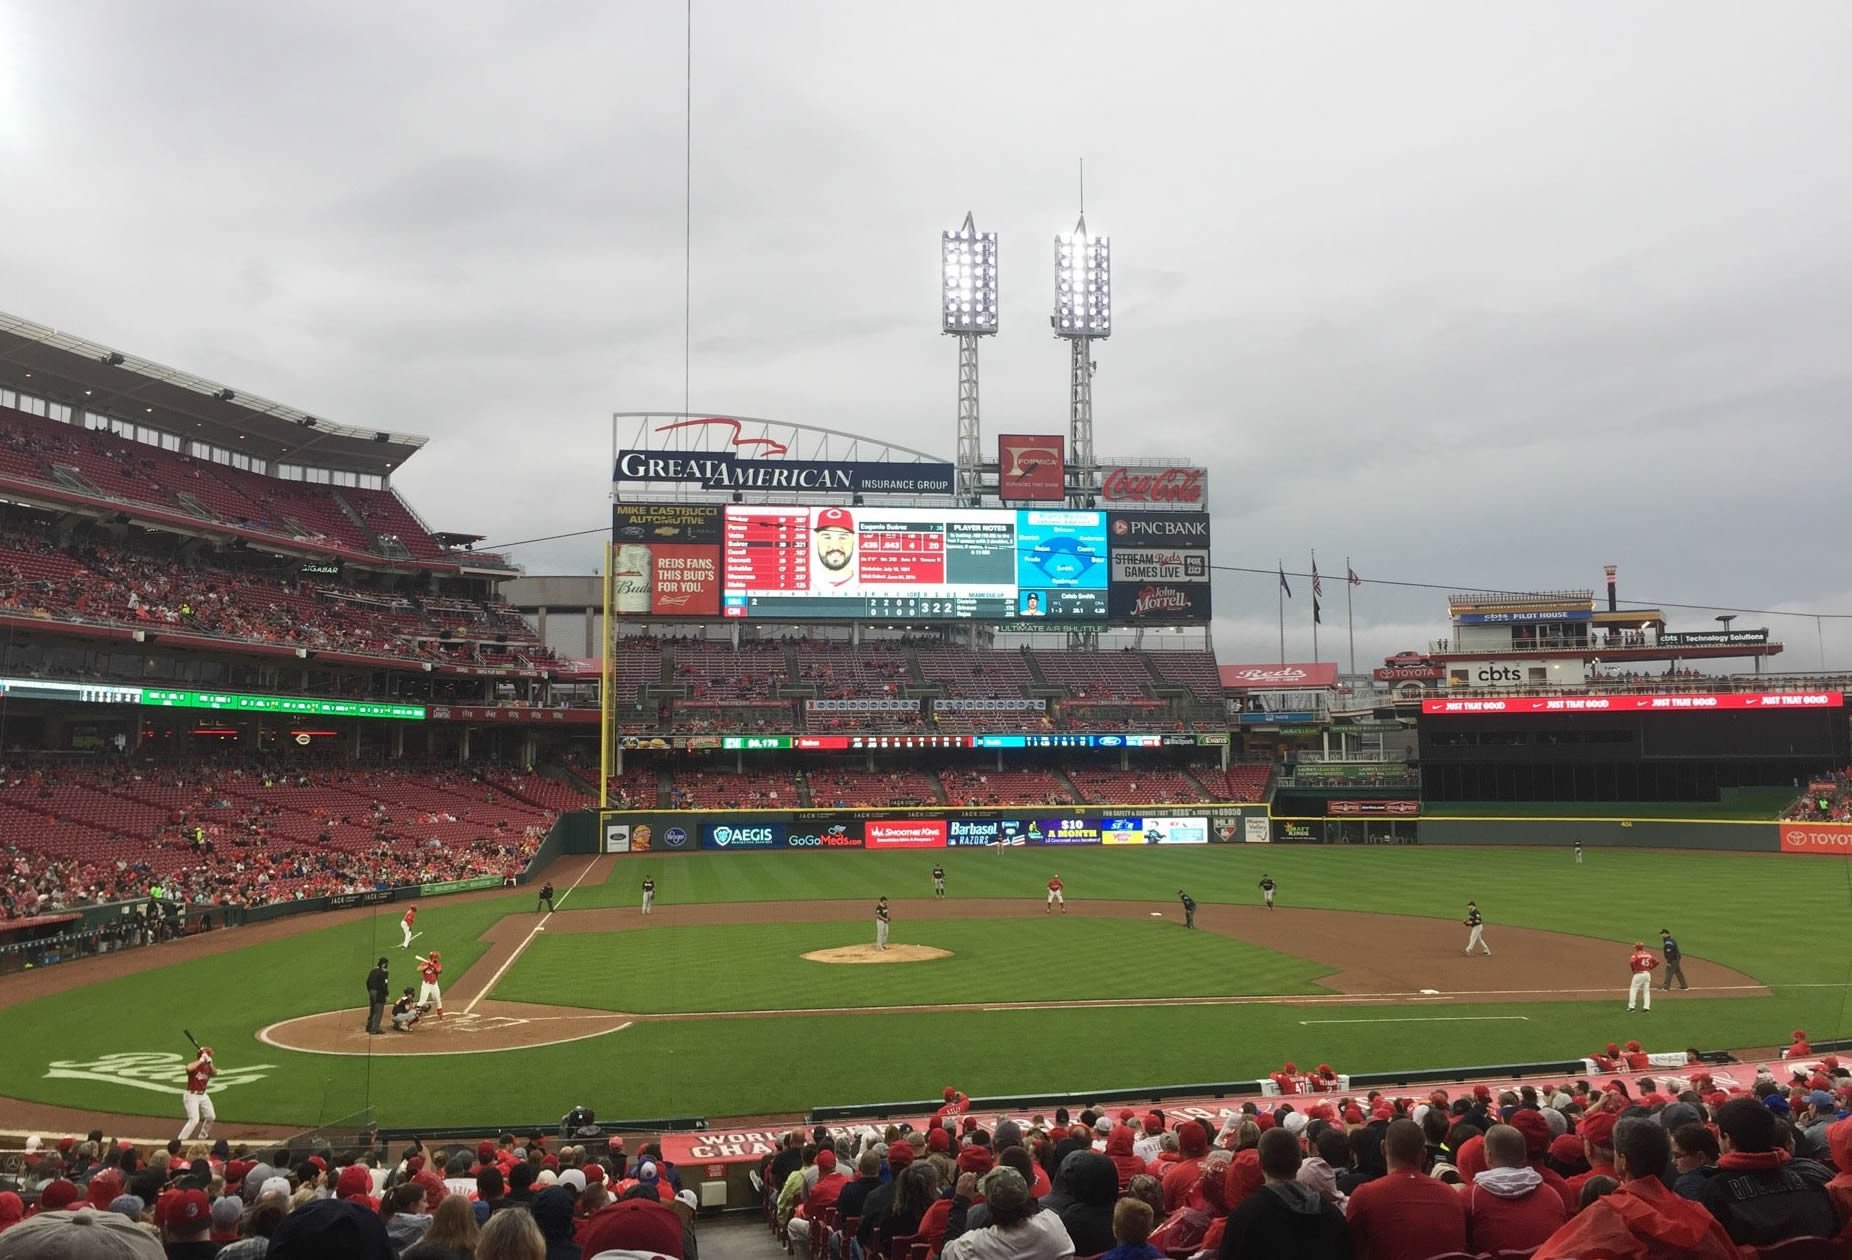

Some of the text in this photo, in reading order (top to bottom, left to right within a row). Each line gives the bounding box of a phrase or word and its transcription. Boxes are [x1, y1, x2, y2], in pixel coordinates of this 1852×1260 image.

[1018, 458, 1058, 466] FORMICA
[861, 479, 914, 490] INSURANCE
[917, 480, 949, 490] GROUP
[617, 506, 646, 514] MIKE
[629, 516, 705, 524] AUTOMOTIVE
[861, 523, 885, 531] Eugenio
[1131, 522, 1207, 535] PNC BANK
[658, 558, 715, 570] REDS FANS,
[1115, 552, 1183, 566] STREAM Reds
[1187, 557, 1202, 566] FOX
[1124, 566, 1180, 578] GAMES LIVE
[1188, 566, 1201, 574] GO
[658, 570, 715, 581] THIS BUD'S
[658, 582, 704, 592] FOR YOU.
[1152, 586, 1176, 598] John
[751, 598, 915, 607] 2 2 2 0 0
[921, 602, 952, 613] 3 2 2
[1130, 592, 1192, 615] Morrell
[871, 608, 877, 616] 0
[884, 608, 889, 616] 1
[896, 608, 902, 616] 0
[909, 608, 915, 616] 0
[1540, 611, 1569, 619] HOUSE
[1000, 623, 1044, 632] ULTIMATE
[1660, 632, 1764, 644] cbts Technology Solutions
[1235, 667, 1308, 680] Reds
[1396, 668, 1435, 678] TOYOTA
[1478, 666, 1522, 682] cbts
[1546, 699, 1609, 709] JUST THAT GOOD
[1652, 699, 1671, 707] JUST
[1693, 698, 1717, 706] GOOD
[1782, 696, 1802, 704] THAT
[1803, 696, 1829, 704] GOOD
[1445, 702, 1506, 710] JUST THAT GOOD
[1205, 736, 1228, 745] Evans
[951, 821, 998, 836] Barbasol
[1061, 819, 1084, 829] $10
[731, 828, 772, 841] AEGIS
[1058, 829, 1098, 837] MONTH
[789, 834, 862, 846] GoGoMeds.com
[959, 835, 989, 845] RAZORS
[1640, 958, 1650, 967] 45
